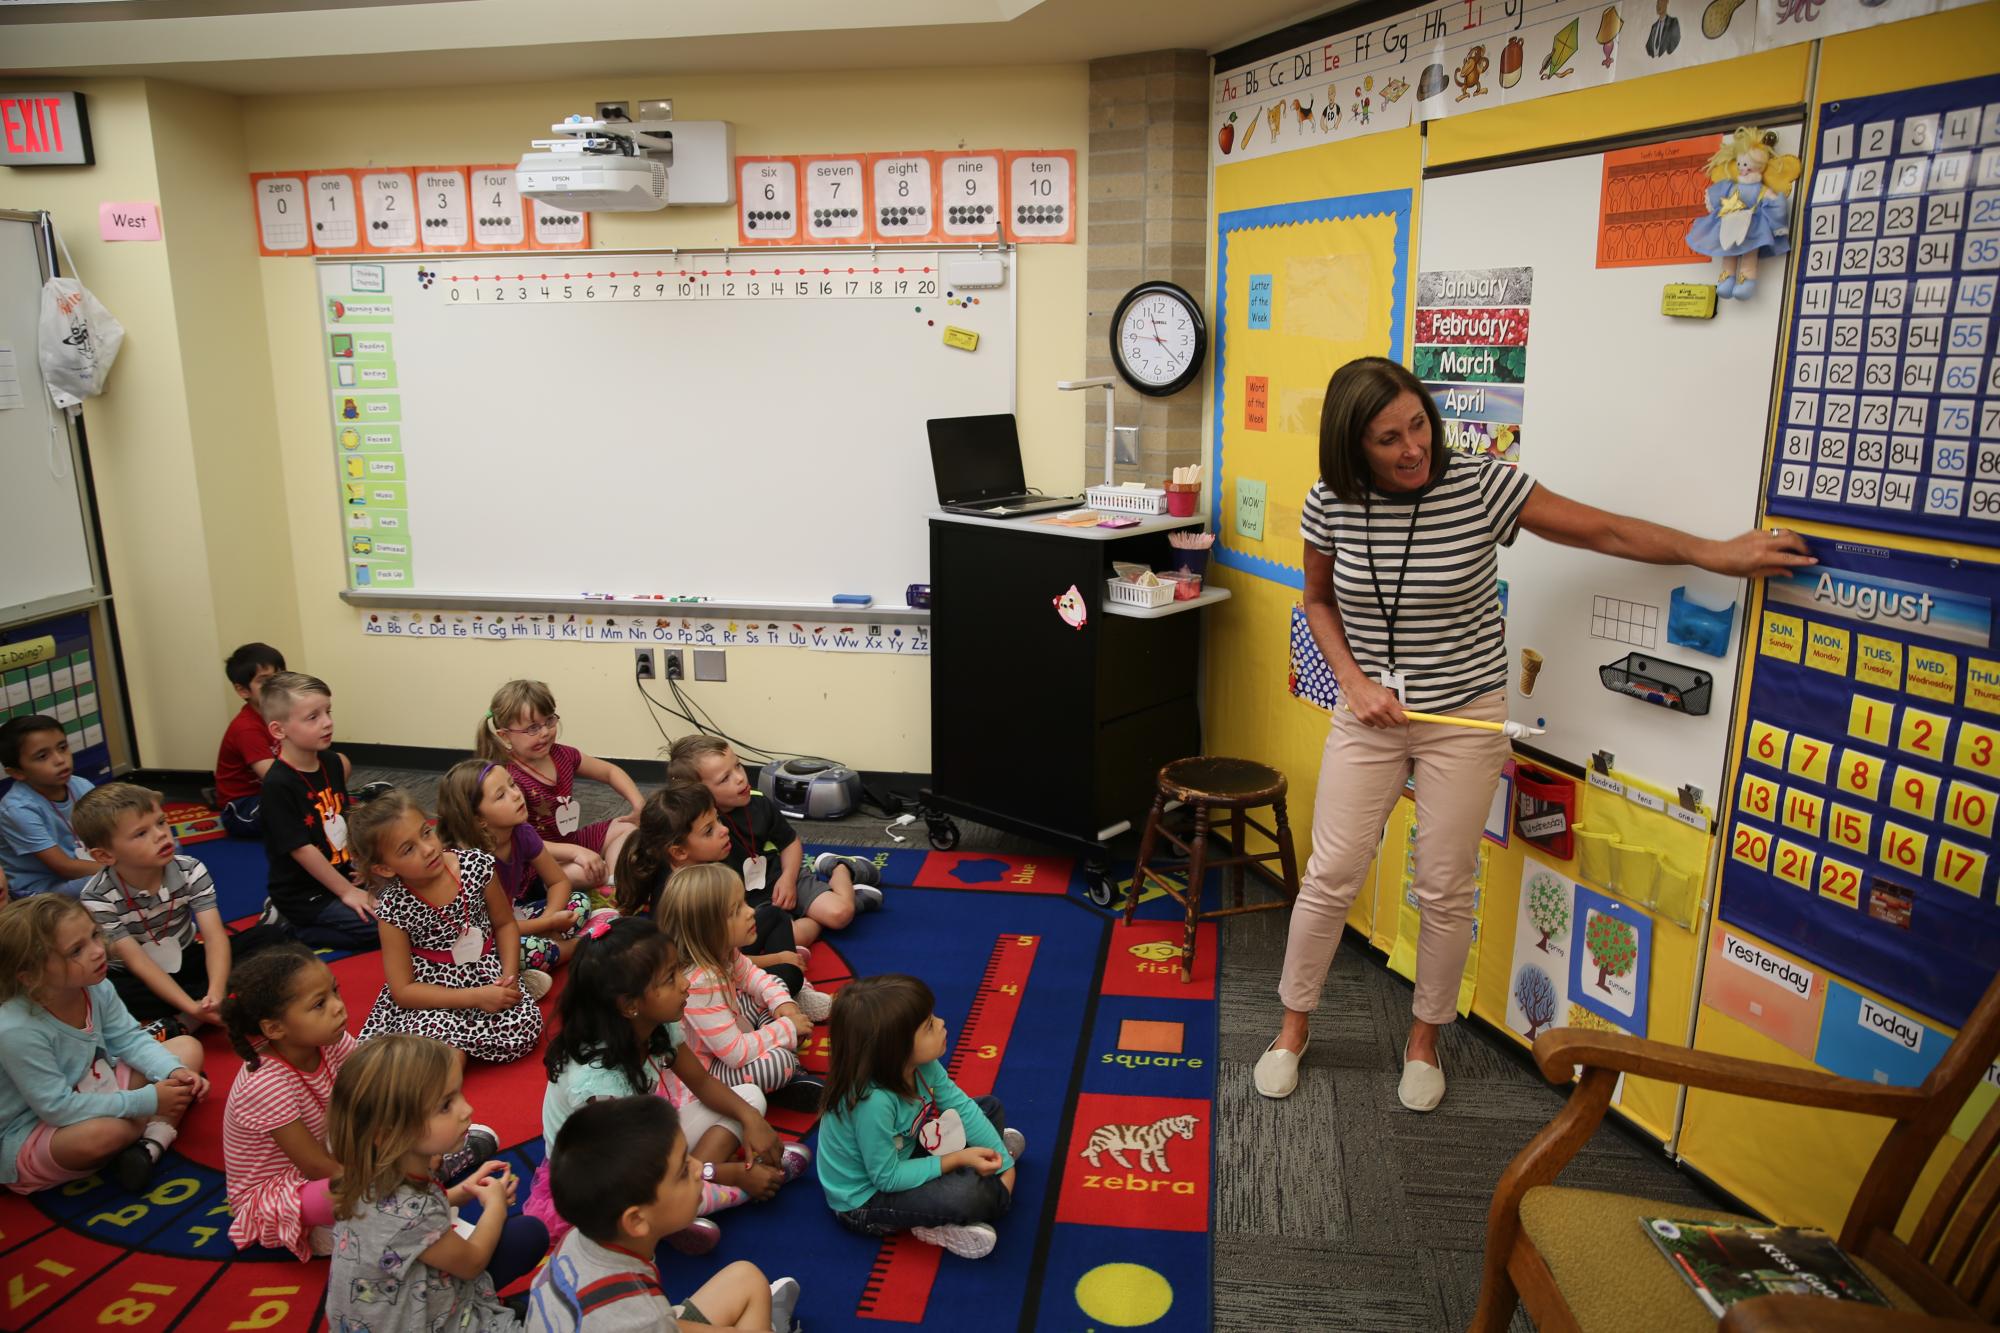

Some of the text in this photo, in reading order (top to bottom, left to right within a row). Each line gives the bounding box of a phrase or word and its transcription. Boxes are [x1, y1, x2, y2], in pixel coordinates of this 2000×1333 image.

[1222, 9, 1446, 102] Aa Bb Cc Dd Ee Ff Gg Hh
[0, 98, 63, 153] EXIT
[1870, 130, 1884, 151] 2
[761, 166, 777, 178] six
[817, 166, 854, 177] seven
[888, 162, 918, 175] eight
[958, 162, 983, 173] nine
[1031, 162, 1051, 173] ten
[268, 183, 292, 193] zero
[321, 181, 340, 190] one
[378, 180, 398, 189] two
[427, 177, 455, 187] three
[484, 175, 507, 186] four
[898, 180, 909, 197] 8
[966, 179, 976, 195] 9
[1030, 179, 1051, 196] 10
[1857, 170, 1876, 191] 12
[764, 184, 775, 200] 6
[830, 182, 841, 199] 7
[277, 199, 287, 214] 0
[329, 196, 335, 211] 1
[385, 196, 395, 211] 2
[438, 193, 447, 208] 3
[492, 192, 502, 207] 4
[112, 213, 146, 228] West
[1929, 202, 1959, 225] 24
[1876, 246, 1904, 267] 33
[1968, 239, 1999, 263] 35
[723, 281, 935, 296] 12 13 14 15 16 17 18 19 20
[1251, 282, 1269, 290] Letter
[1437, 277, 1509, 302] January
[1251, 296, 1268, 306] of the
[1838, 285, 1863, 308] 42
[1154, 303, 1165, 313] 12
[1133, 320, 1144, 329] 10
[1178, 319, 1185, 330] 2
[1252, 312, 1268, 322] Week
[1432, 313, 1509, 342] February
[1181, 335, 1188, 345] 3
[1909, 327, 1939, 347] 54
[1133, 348, 1140, 358] 8
[1167, 361, 1175, 371] 5
[1440, 351, 1494, 374] March
[1799, 363, 1819, 383] 61
[1866, 364, 1891, 384] 63
[1250, 382, 1264, 392] Word
[1248, 397, 1264, 408] of the
[1444, 388, 1485, 416] April
[1249, 413, 1263, 424] Week
[1828, 403, 1850, 423] 72
[1943, 408, 1969, 430] 75
[1444, 425, 1481, 454] May
[1858, 441, 1882, 462] 83
[1816, 475, 1839, 495] 92
[1884, 482, 1910, 503] 94
[1243, 496, 1259, 508] WOW
[1242, 519, 1256, 530] Word
[1814, 572, 1934, 623] August
[366, 623, 928, 652] Aa Bb Cc Dd Gg Hh Kk Mm Nn Oo Pp Rr Uu Vv Ww Xx Yy Zz
[1770, 623, 1795, 638] SUN.
[1769, 639, 1793, 651] Sunday
[1813, 634, 1843, 650] MON.
[11, 645, 43, 662] Doing?
[1813, 650, 1840, 663] Monday
[1864, 647, 1894, 663] TUES.
[1863, 663, 1893, 676] Tuesday
[1916, 659, 1947, 676] WED.
[1909, 674, 1954, 691] Wednesday
[1912, 720, 1933, 752] 2
[1758, 732, 1774, 757] 6
[1971, 735, 1993, 767] 3
[1591, 774, 1620, 792] hundreds
[1851, 761, 1868, 789] 8
[1638, 792, 1652, 805] tens
[1746, 782, 1769, 813] 13
[1905, 779, 1924, 810] 9
[1952, 791, 1985, 826] 10
[1525, 818, 1564, 831] Wednesday
[1678, 811, 1695, 823] ones
[1835, 811, 1862, 844] 15
[1735, 830, 1767, 863] 20
[1889, 831, 1916, 865] 16
[1944, 849, 1975, 882] 17
[1010, 864, 1037, 884] blue
[1821, 865, 1857, 900] 22
[1017, 936, 1033, 946] 5
[1548, 943, 1564, 957] spring
[1727, 938, 1810, 993] Yesterday
[1001, 985, 1018, 995] 4
[1608, 980, 1631, 996] summer
[1865, 1004, 1918, 1048] Today
[978, 1046, 998, 1058] 3
[1102, 1054, 1203, 1068] square
[1083, 1174, 1195, 1194] zebra
[1759, 1243, 1800, 1272] Kiss
